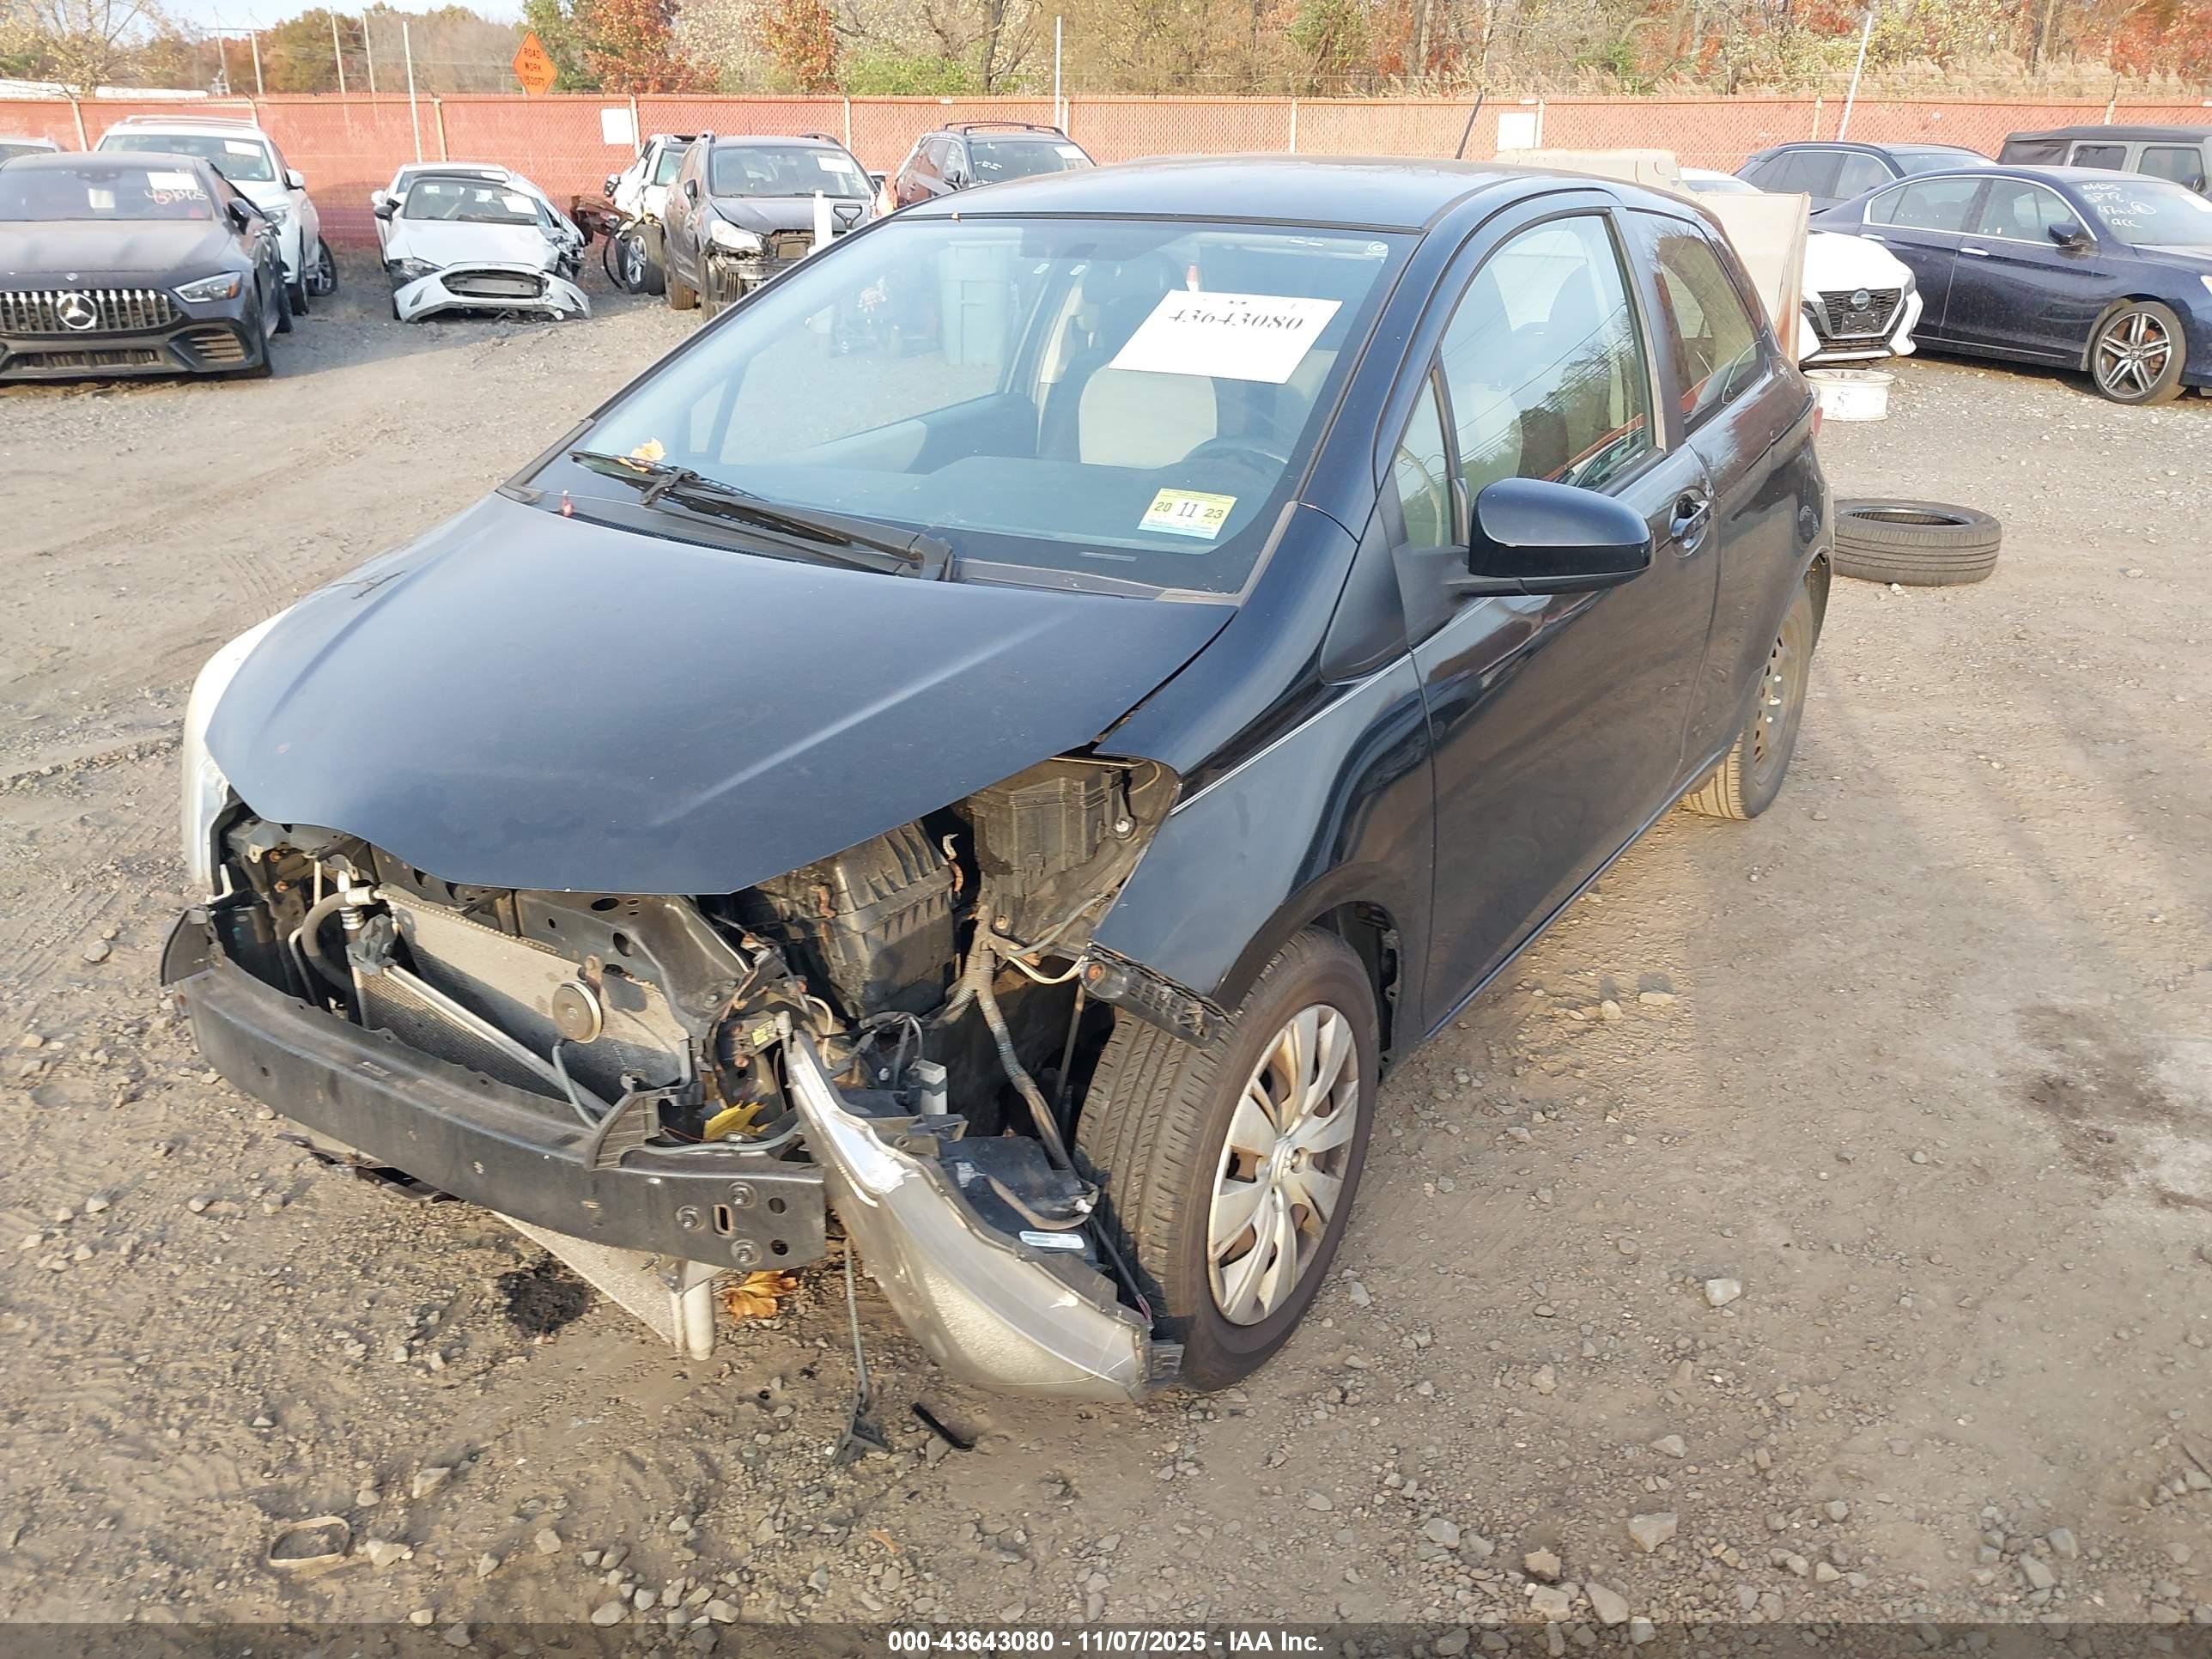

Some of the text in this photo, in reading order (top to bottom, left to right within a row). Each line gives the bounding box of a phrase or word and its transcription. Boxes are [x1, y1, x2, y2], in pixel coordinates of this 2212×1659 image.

[523, 47, 542, 59] ROAD
[524, 62, 543, 72] WORK
[1168, 308, 1304, 331] 43643080
[1154, 501, 1224, 519] 20 11 23
